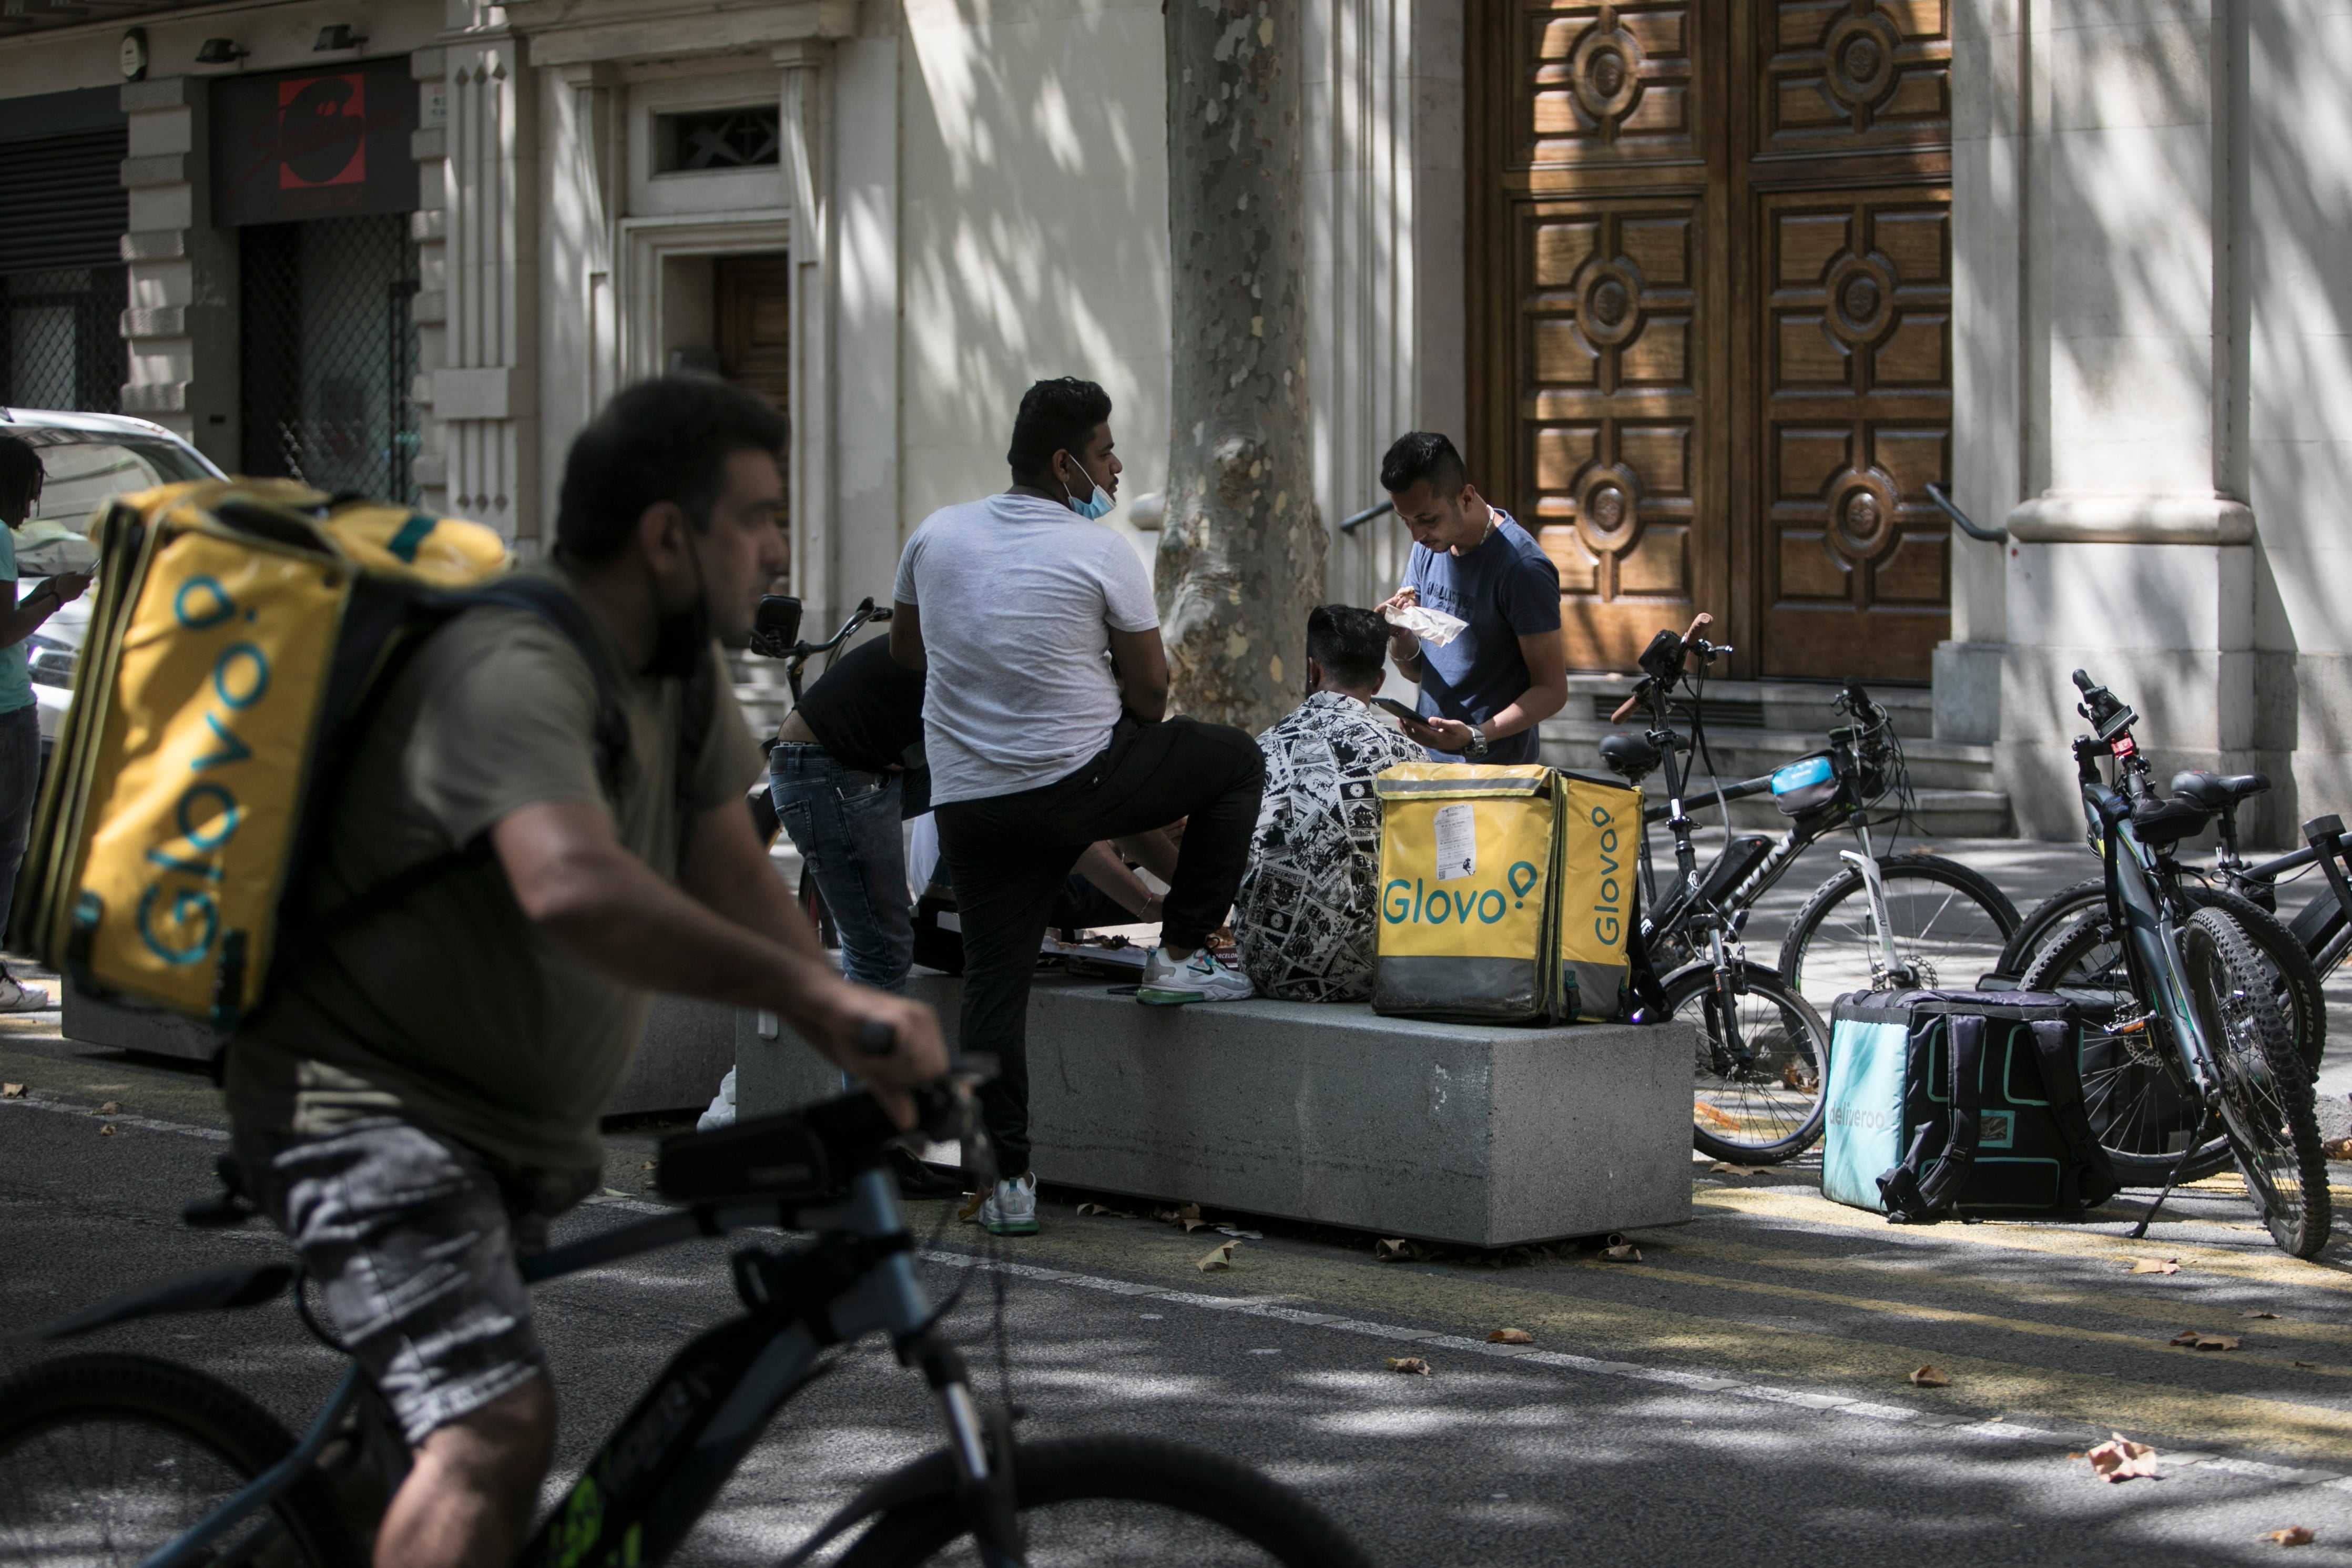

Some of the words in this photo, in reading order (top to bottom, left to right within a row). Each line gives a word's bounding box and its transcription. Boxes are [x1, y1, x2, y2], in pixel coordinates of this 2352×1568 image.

[137, 640, 269, 965] Glovo
[1383, 878, 1506, 925] Glovo
[1594, 828, 1620, 945] Glovo
[2297, 980, 2314, 1044] KENDA
[1829, 1100, 1885, 1129] deliveroo
